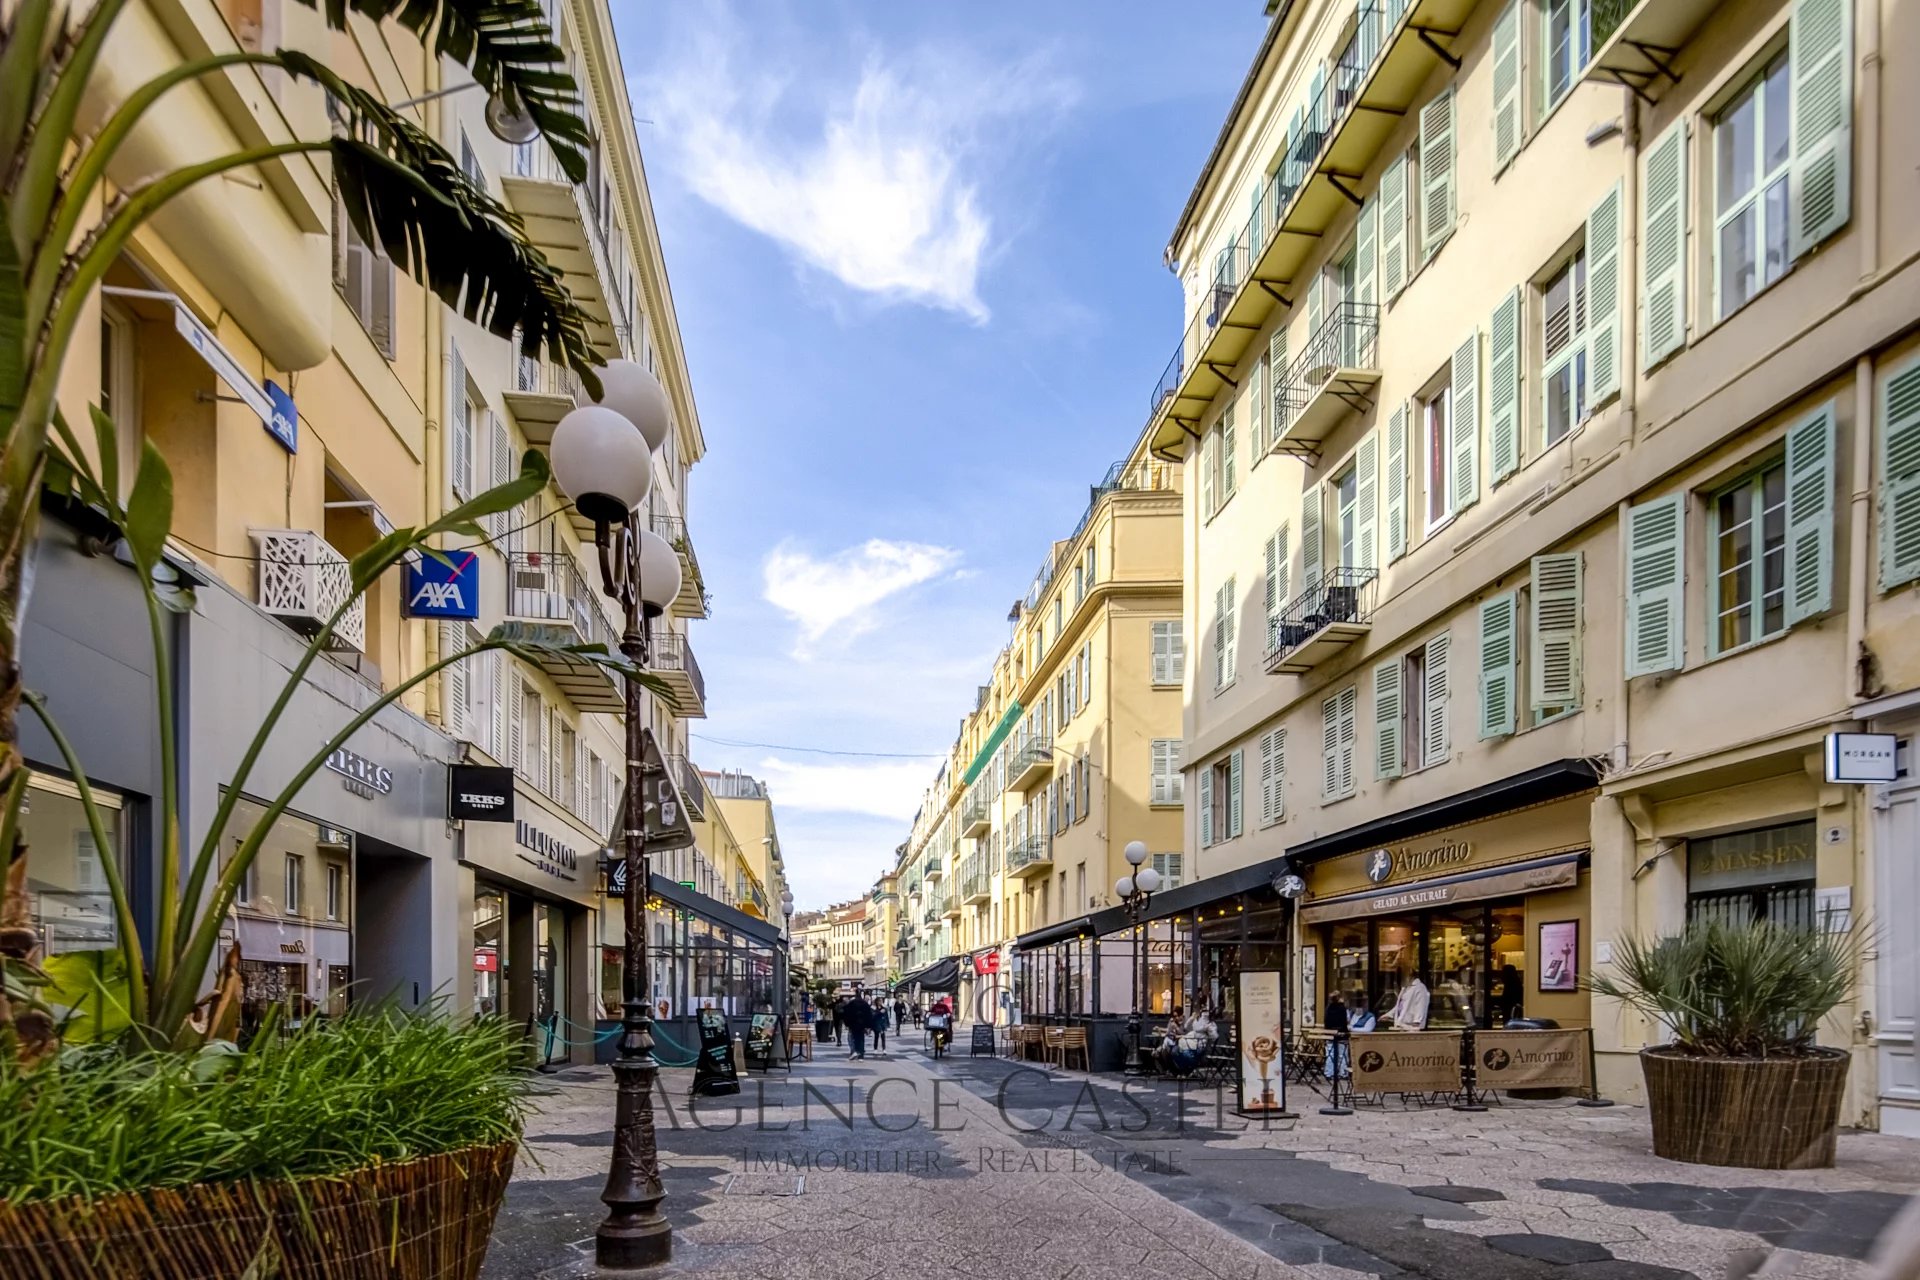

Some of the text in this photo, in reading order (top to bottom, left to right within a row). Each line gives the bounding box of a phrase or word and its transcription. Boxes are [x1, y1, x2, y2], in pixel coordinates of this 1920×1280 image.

[272, 412, 294, 445] AXA
[410, 582, 465, 610] AXA
[1844, 750, 1891, 758] MORGAN
[325, 740, 393, 795] IKKS
[460, 793, 505, 806] IKKS
[515, 819, 577, 871] ILLUSION
[1831, 829, 1840, 842] 2
[1395, 839, 1471, 873] Amorino
[1373, 888, 1448, 910] GELATO AL NATURALE
[1385, 1051, 1456, 1067] Amorino
[1511, 1047, 1574, 1064] Amorino
